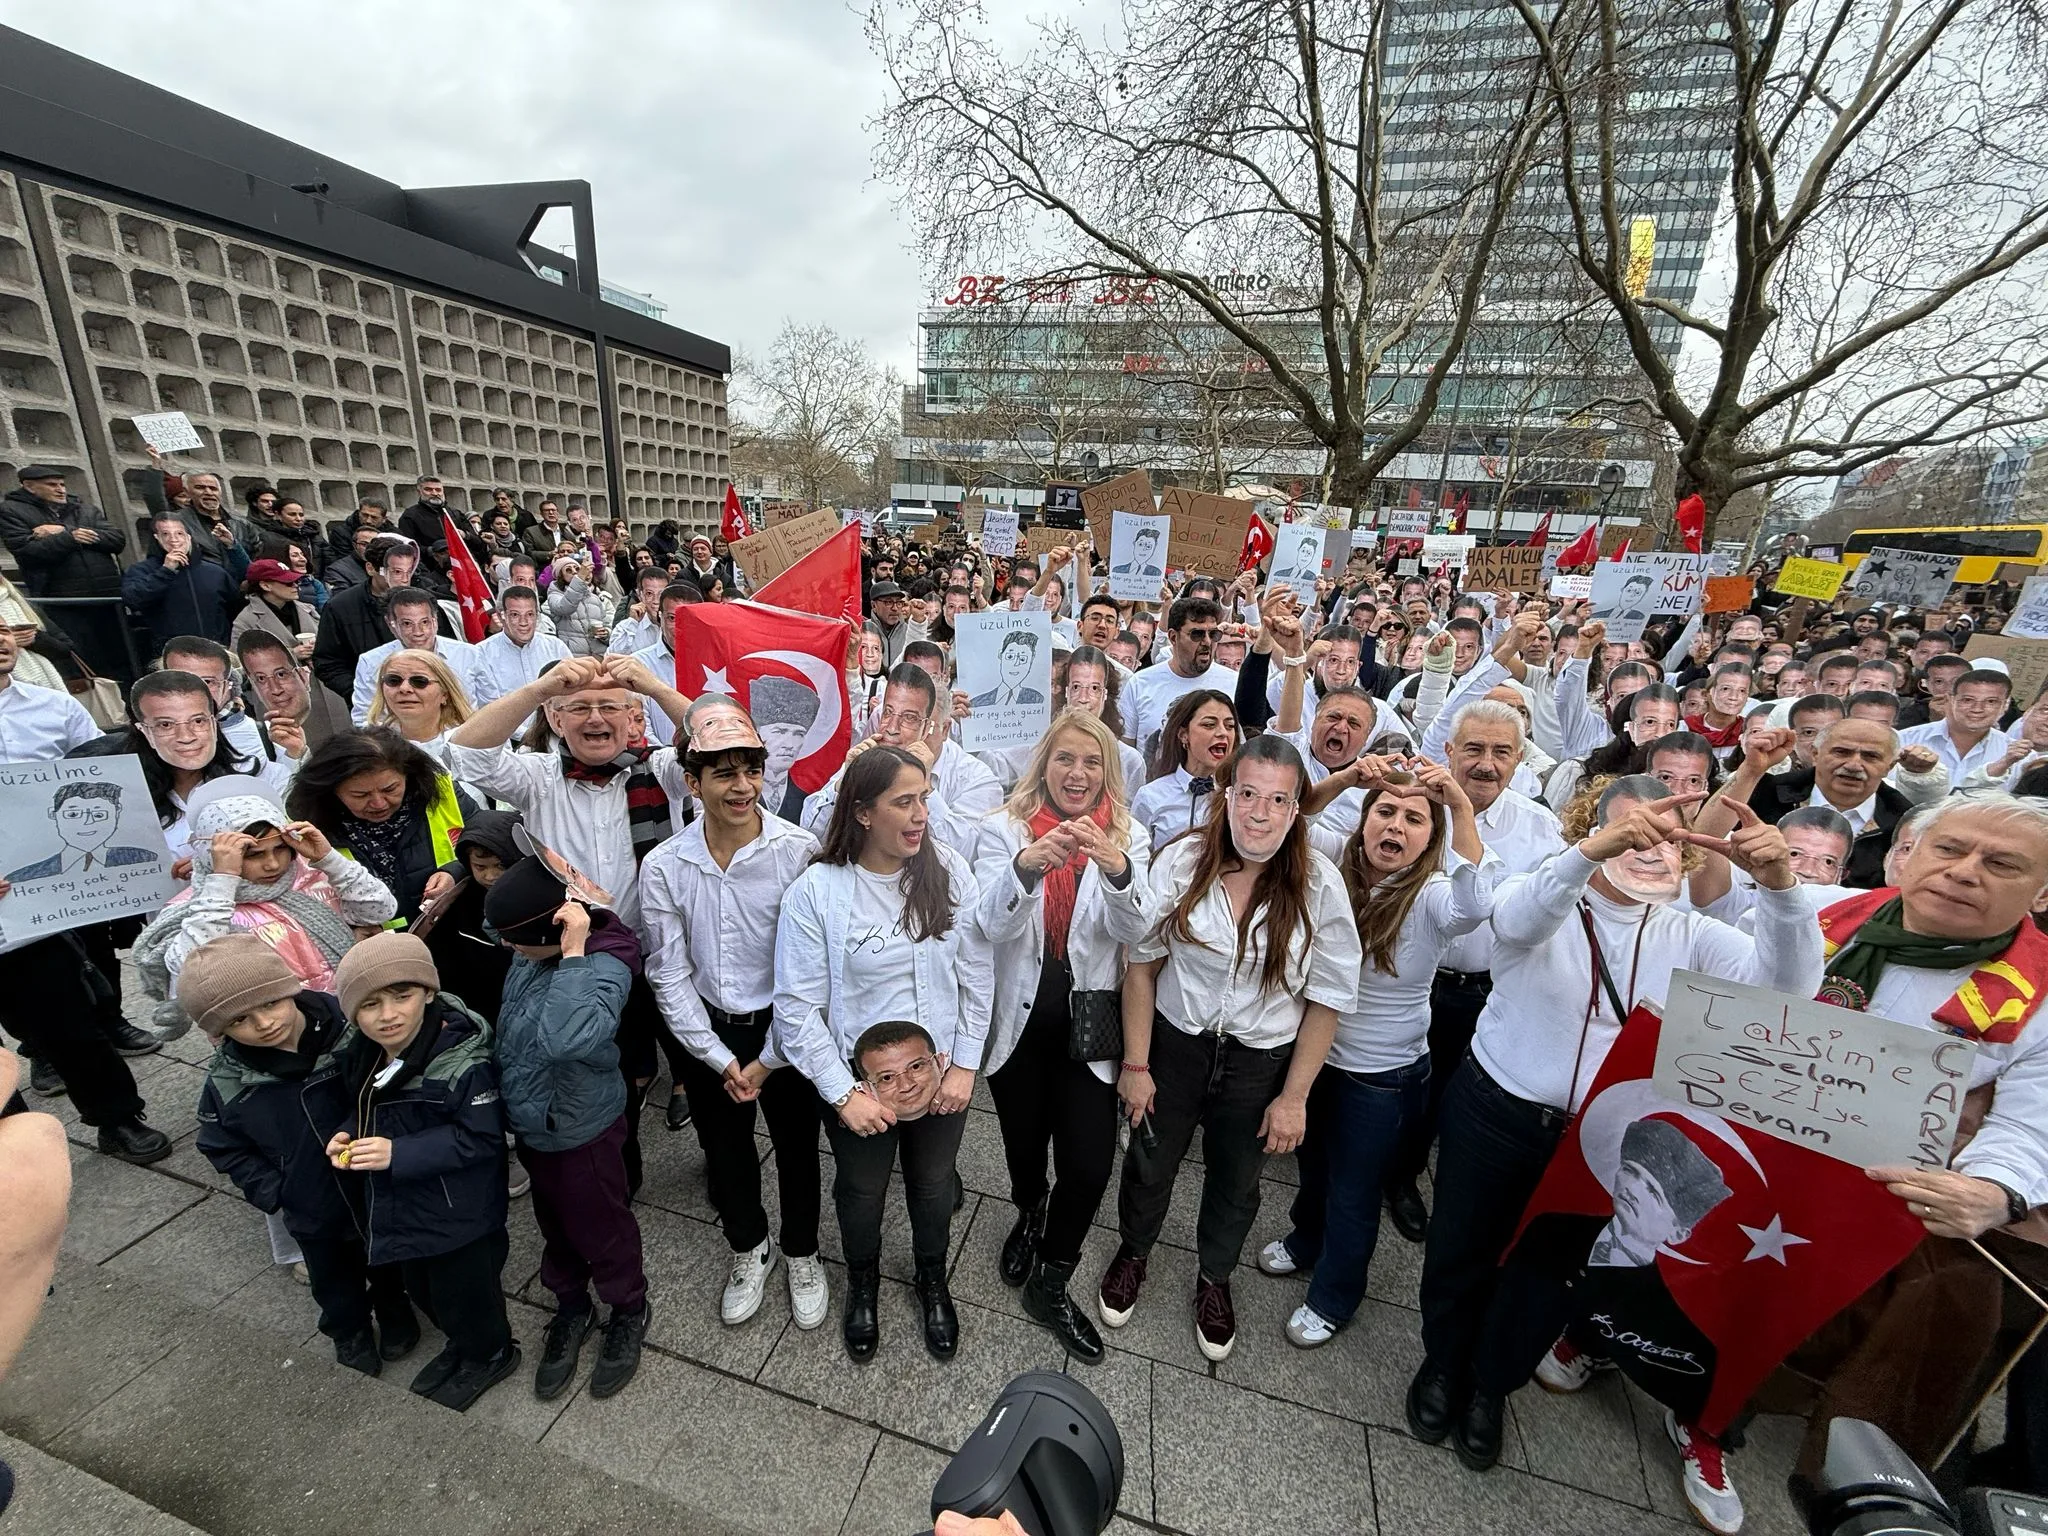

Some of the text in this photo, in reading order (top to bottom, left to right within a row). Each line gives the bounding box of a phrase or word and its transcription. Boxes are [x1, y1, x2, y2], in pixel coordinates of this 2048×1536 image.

[143, 427, 194, 442] SERBEST
[1084, 482, 1137, 512] Diploma
[1160, 489, 1202, 516] AY
[1125, 517, 1156, 527] üzülme
[983, 540, 1012, 554] RECEP
[1468, 547, 1495, 566] HAK
[1871, 547, 1890, 558] JIN
[1896, 551, 1928, 561] JIYAN
[1468, 567, 1541, 588] ADALET
[1612, 565, 1651, 574] üzülme
[1661, 573, 1703, 592] KÜM
[1782, 572, 1837, 591] ADALET
[980, 616, 1032, 630] üzülme
[987, 710, 999, 719] şey
[1003, 708, 1016, 718] çok
[1021, 706, 1044, 719] güzel
[994, 719, 1022, 729] olacak
[975, 730, 1040, 742] #alleswirdgut
[1, 763, 103, 786] üzülme
[13, 864, 163, 898] Her şey çok güzel
[71, 884, 127, 902] olacak
[30, 891, 163, 925] #alleswirdgut
[1721, 1044, 1867, 1095] Selam
[1678, 1080, 1831, 1144] Devam
